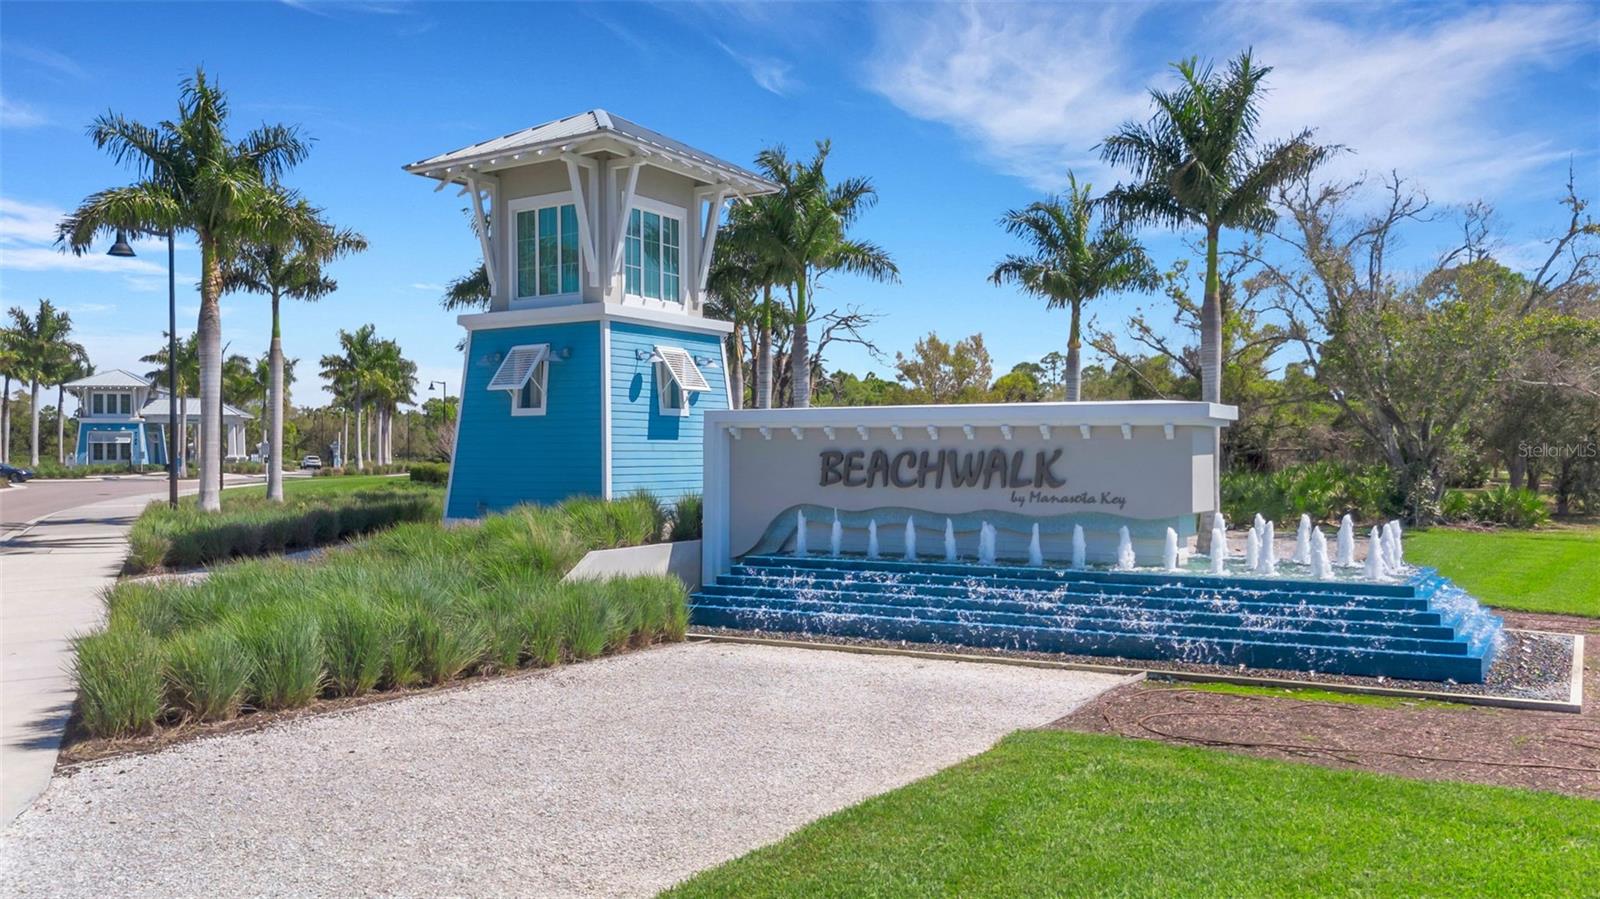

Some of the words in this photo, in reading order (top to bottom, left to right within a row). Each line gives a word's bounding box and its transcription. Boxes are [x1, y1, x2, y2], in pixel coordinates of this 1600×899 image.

[819, 447, 1066, 489] BEACHWALK
[1011, 491, 1025, 507] by
[1029, 491, 1097, 504] Manasota
[1100, 491, 1126, 510] Key
